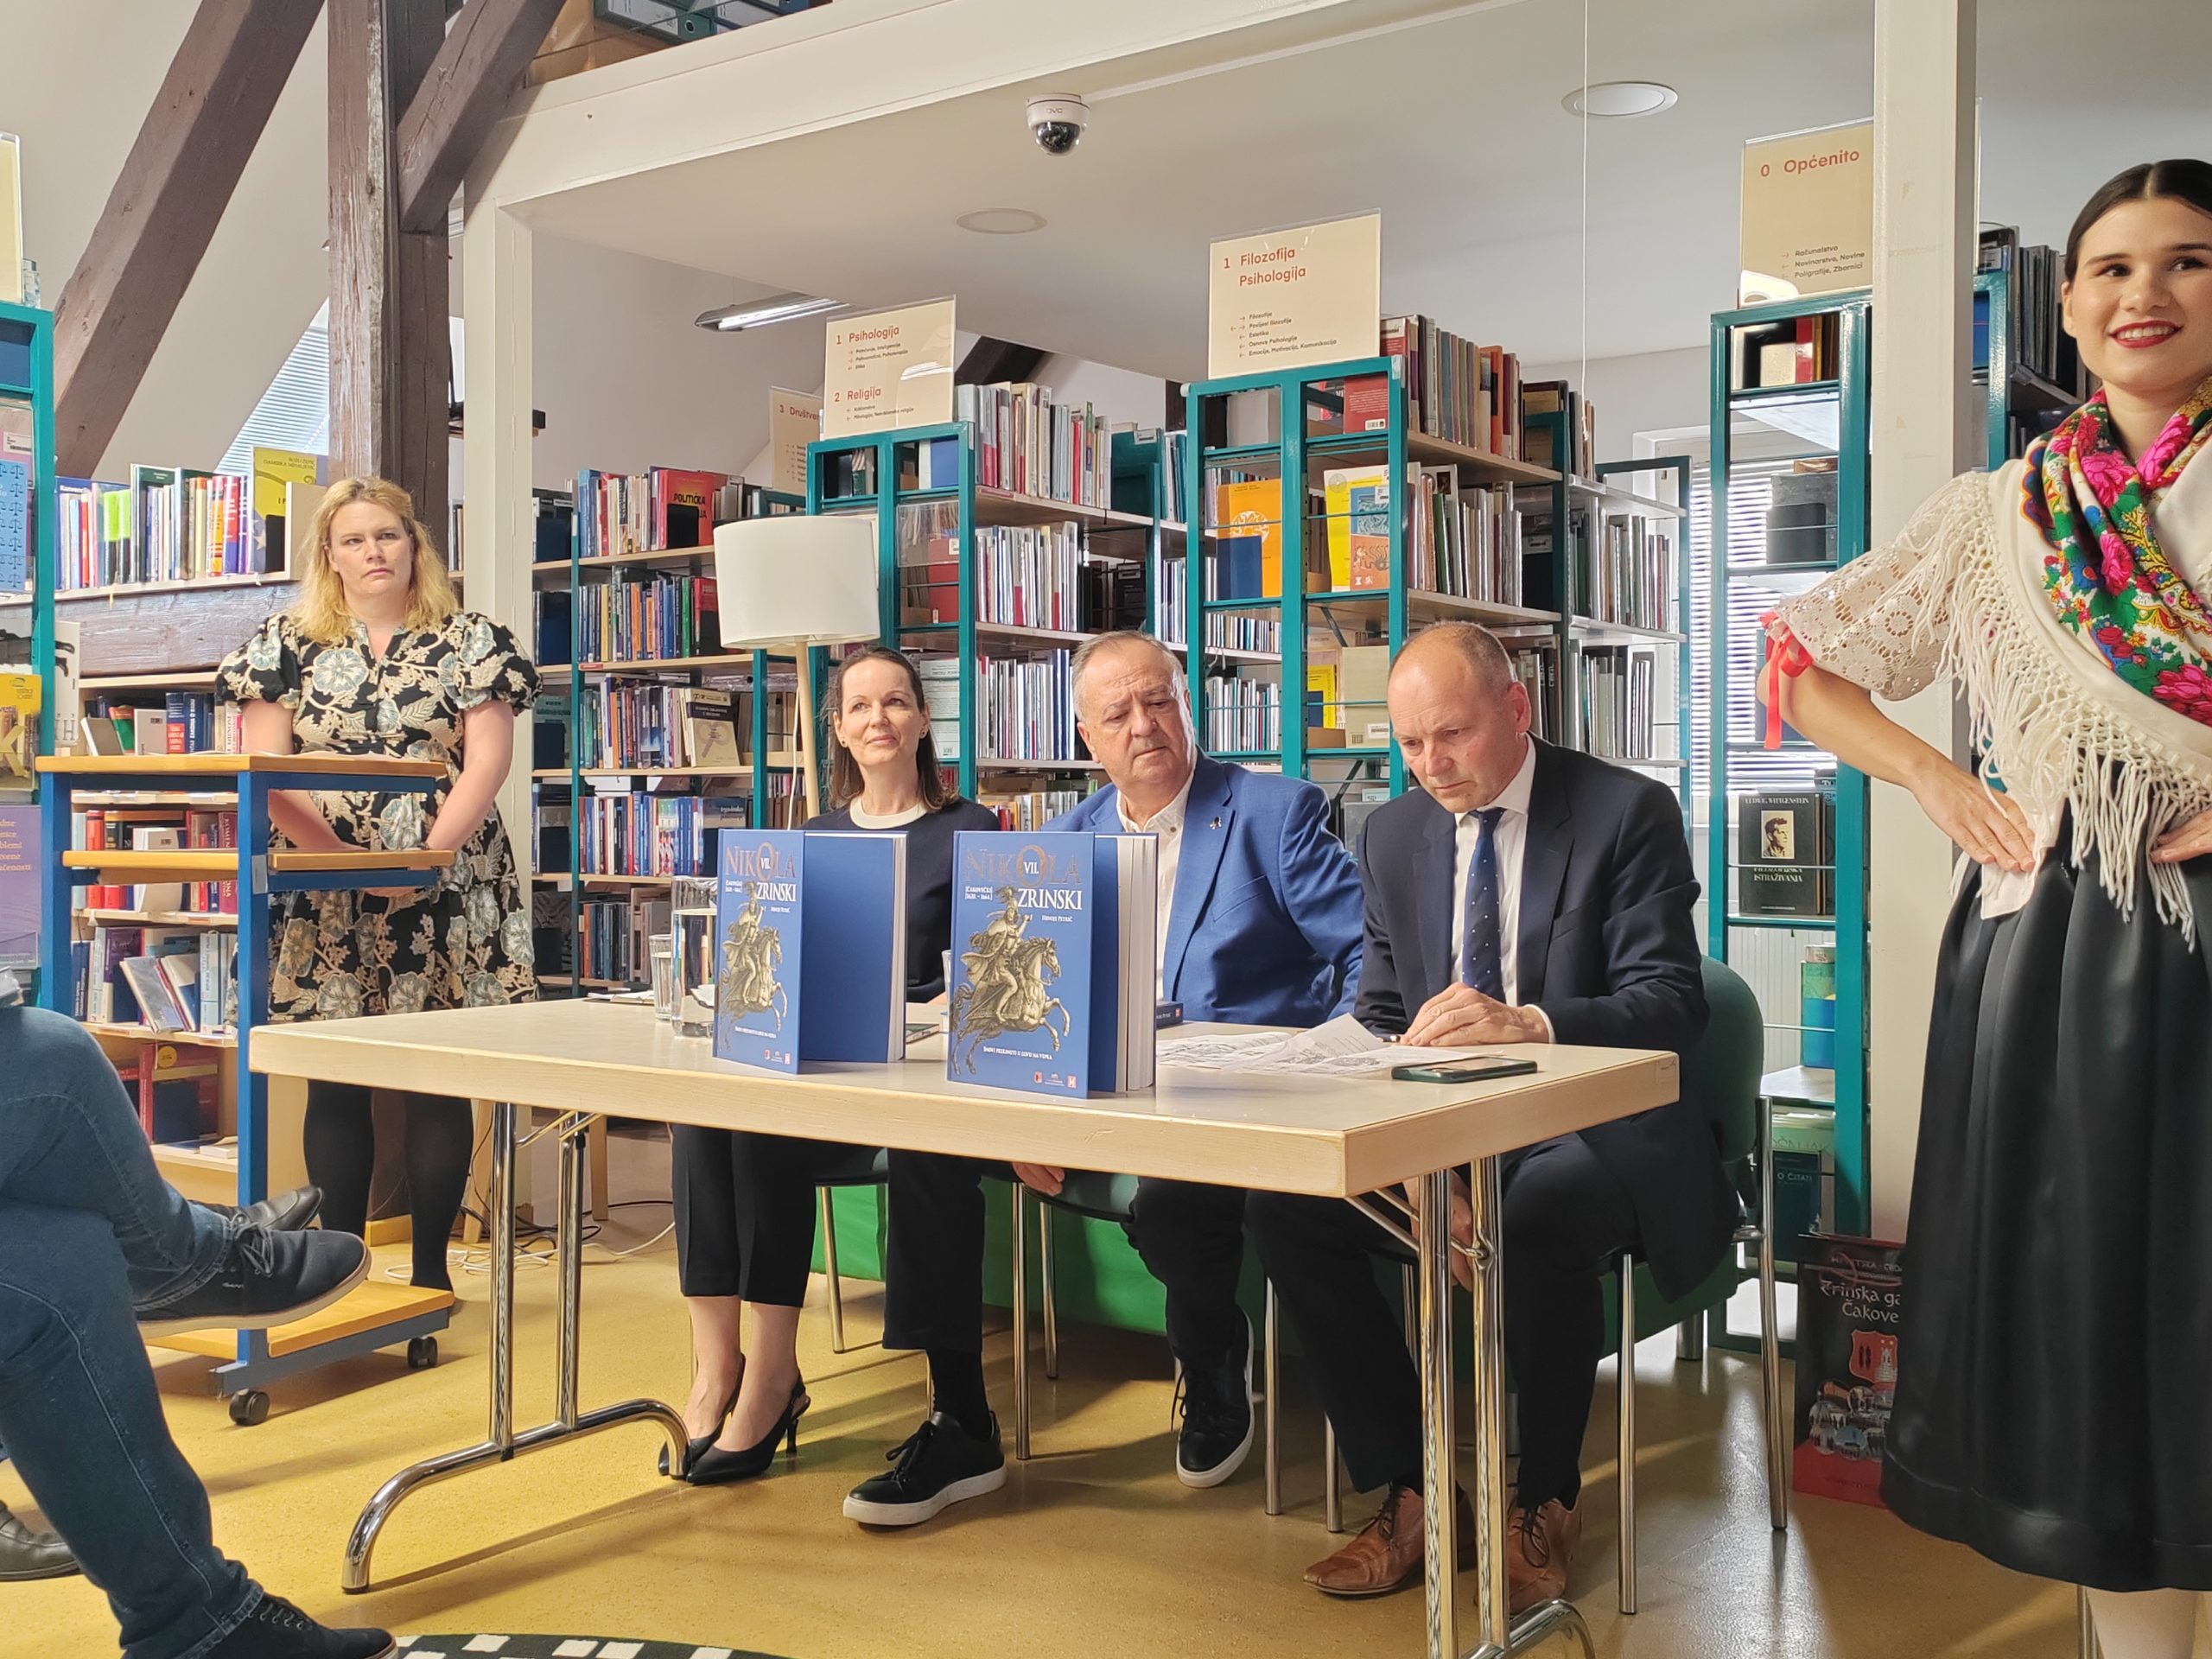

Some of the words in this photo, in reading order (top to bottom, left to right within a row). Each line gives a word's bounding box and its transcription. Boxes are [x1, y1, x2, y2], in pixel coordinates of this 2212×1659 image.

[1760, 164, 1770, 177] 0
[1783, 149, 1859, 175] Općenito
[1224, 257, 1230, 270] 1
[1240, 247, 1295, 266] Filozofija
[1840, 251, 1865, 262] Novine
[1239, 266, 1306, 286] Psihologija
[836, 334, 842, 345] 1
[849, 325, 899, 343] Psihologija
[835, 392, 840, 402] 2
[847, 385, 881, 401] Religija
[779, 404, 785, 413] 3
[673, 493, 706, 505] POLITIČKA
[725, 841, 797, 881] NIKOLA
[963, 844, 1082, 887] NIKOLA
[756, 881, 797, 902] ZRINSKI
[1018, 887, 1082, 910] ZRINSKI
[1821, 1281, 1880, 1303] Zrinska
